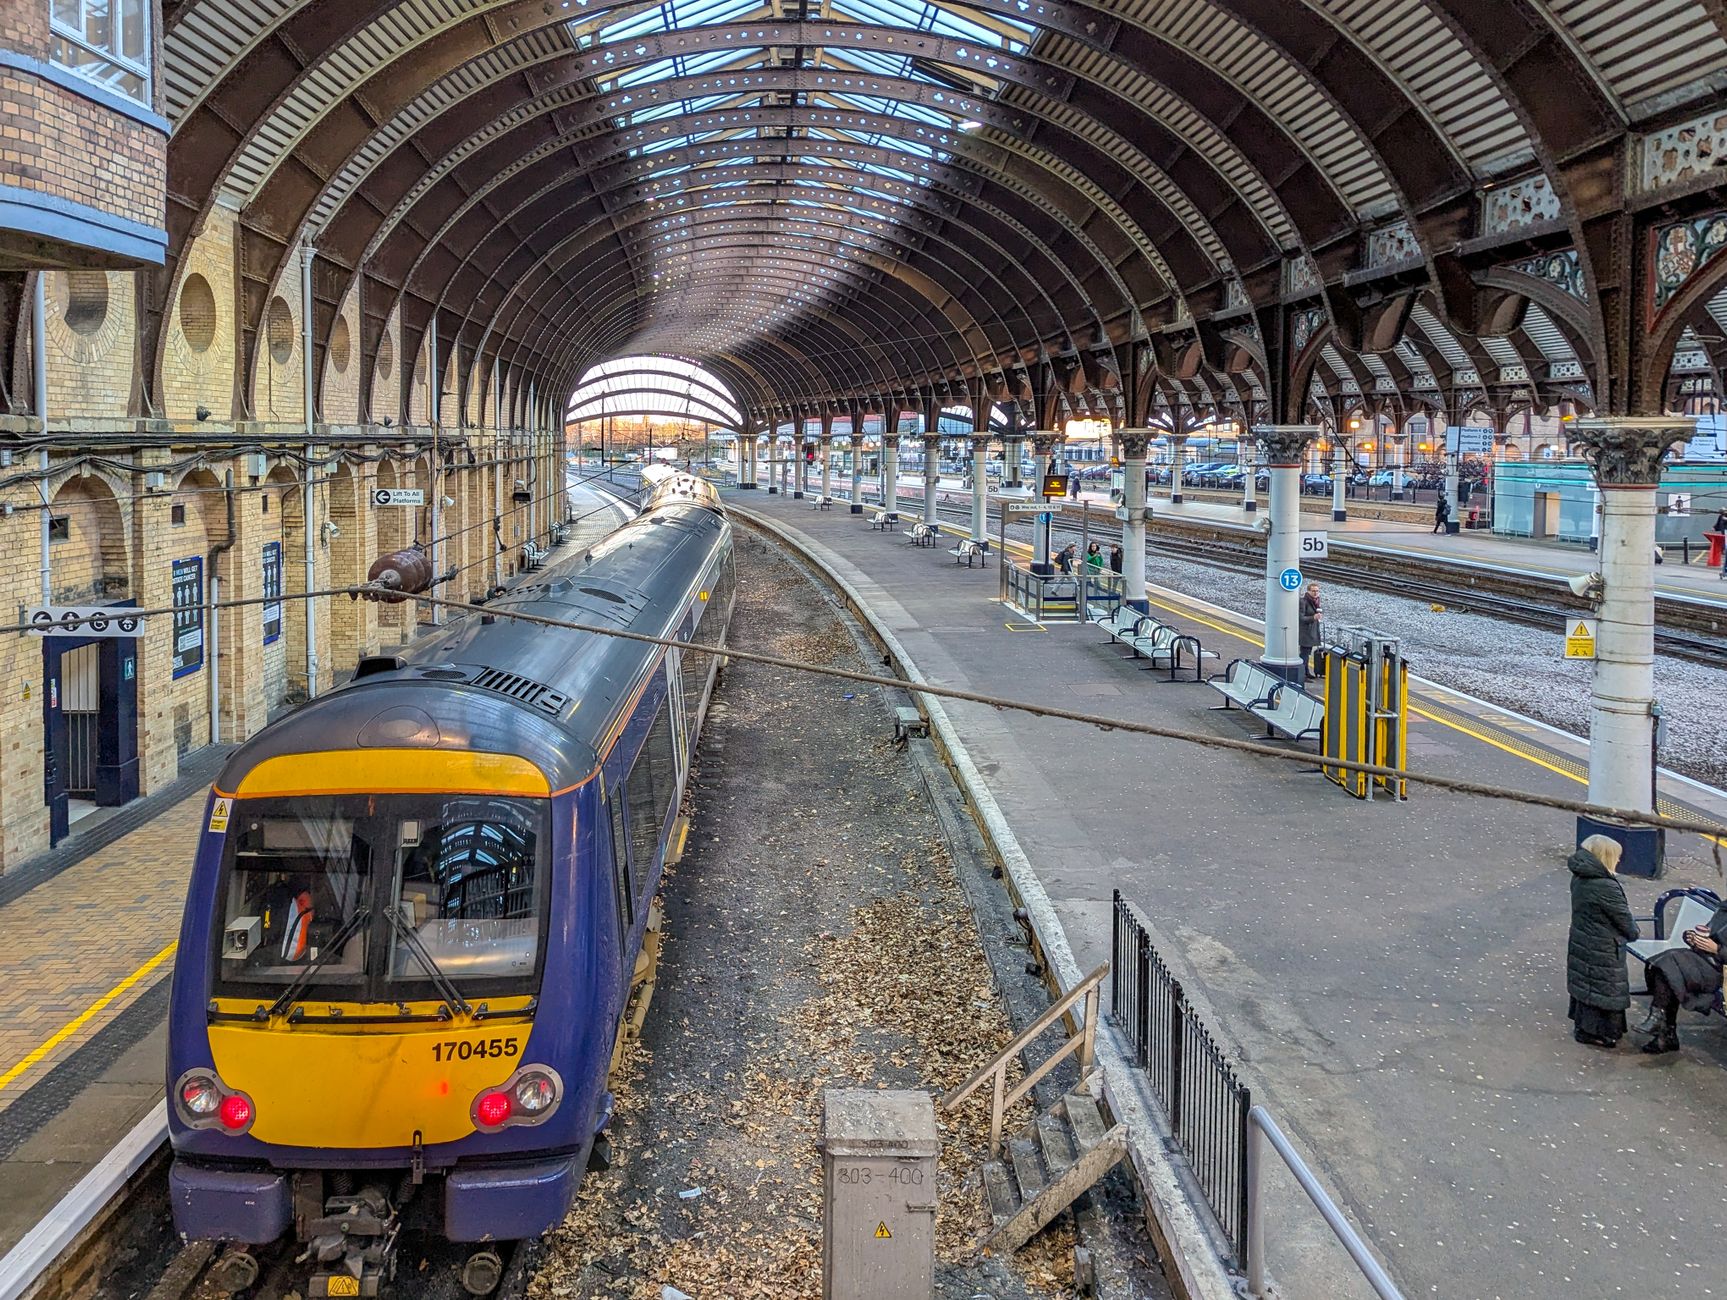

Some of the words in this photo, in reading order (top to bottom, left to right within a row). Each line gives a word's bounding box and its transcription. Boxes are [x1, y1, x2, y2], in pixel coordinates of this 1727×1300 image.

[988, 485, 999, 493] 5b
[1302, 537, 1324, 551] 5b
[1284, 575, 1299, 587] 13
[432, 1037, 518, 1062] 170455
